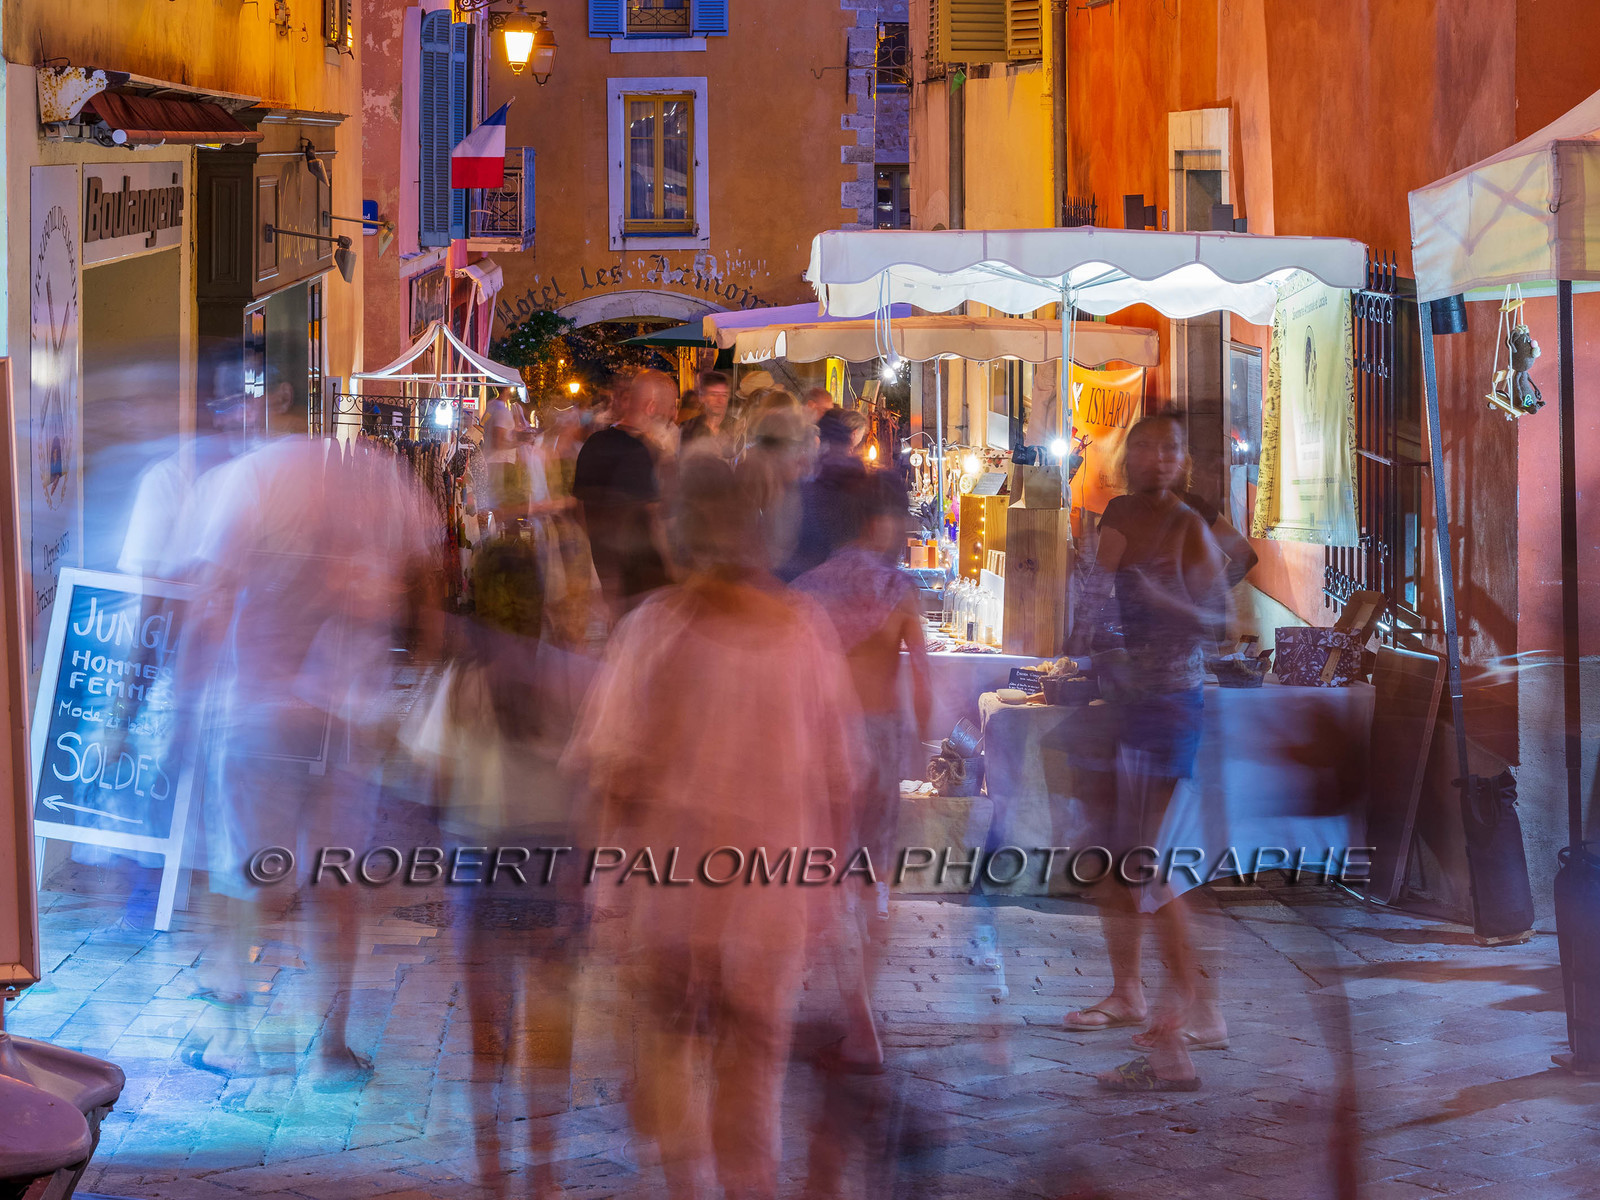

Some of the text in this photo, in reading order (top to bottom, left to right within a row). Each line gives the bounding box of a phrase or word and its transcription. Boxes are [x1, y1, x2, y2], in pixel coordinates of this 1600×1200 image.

[84, 172, 184, 248] Boulangerie
[647, 254, 777, 309] Armoir
[1086, 387, 1131, 429] ISNARD
[73, 597, 177, 654] JUNGL
[52, 731, 170, 801] SOLDES
